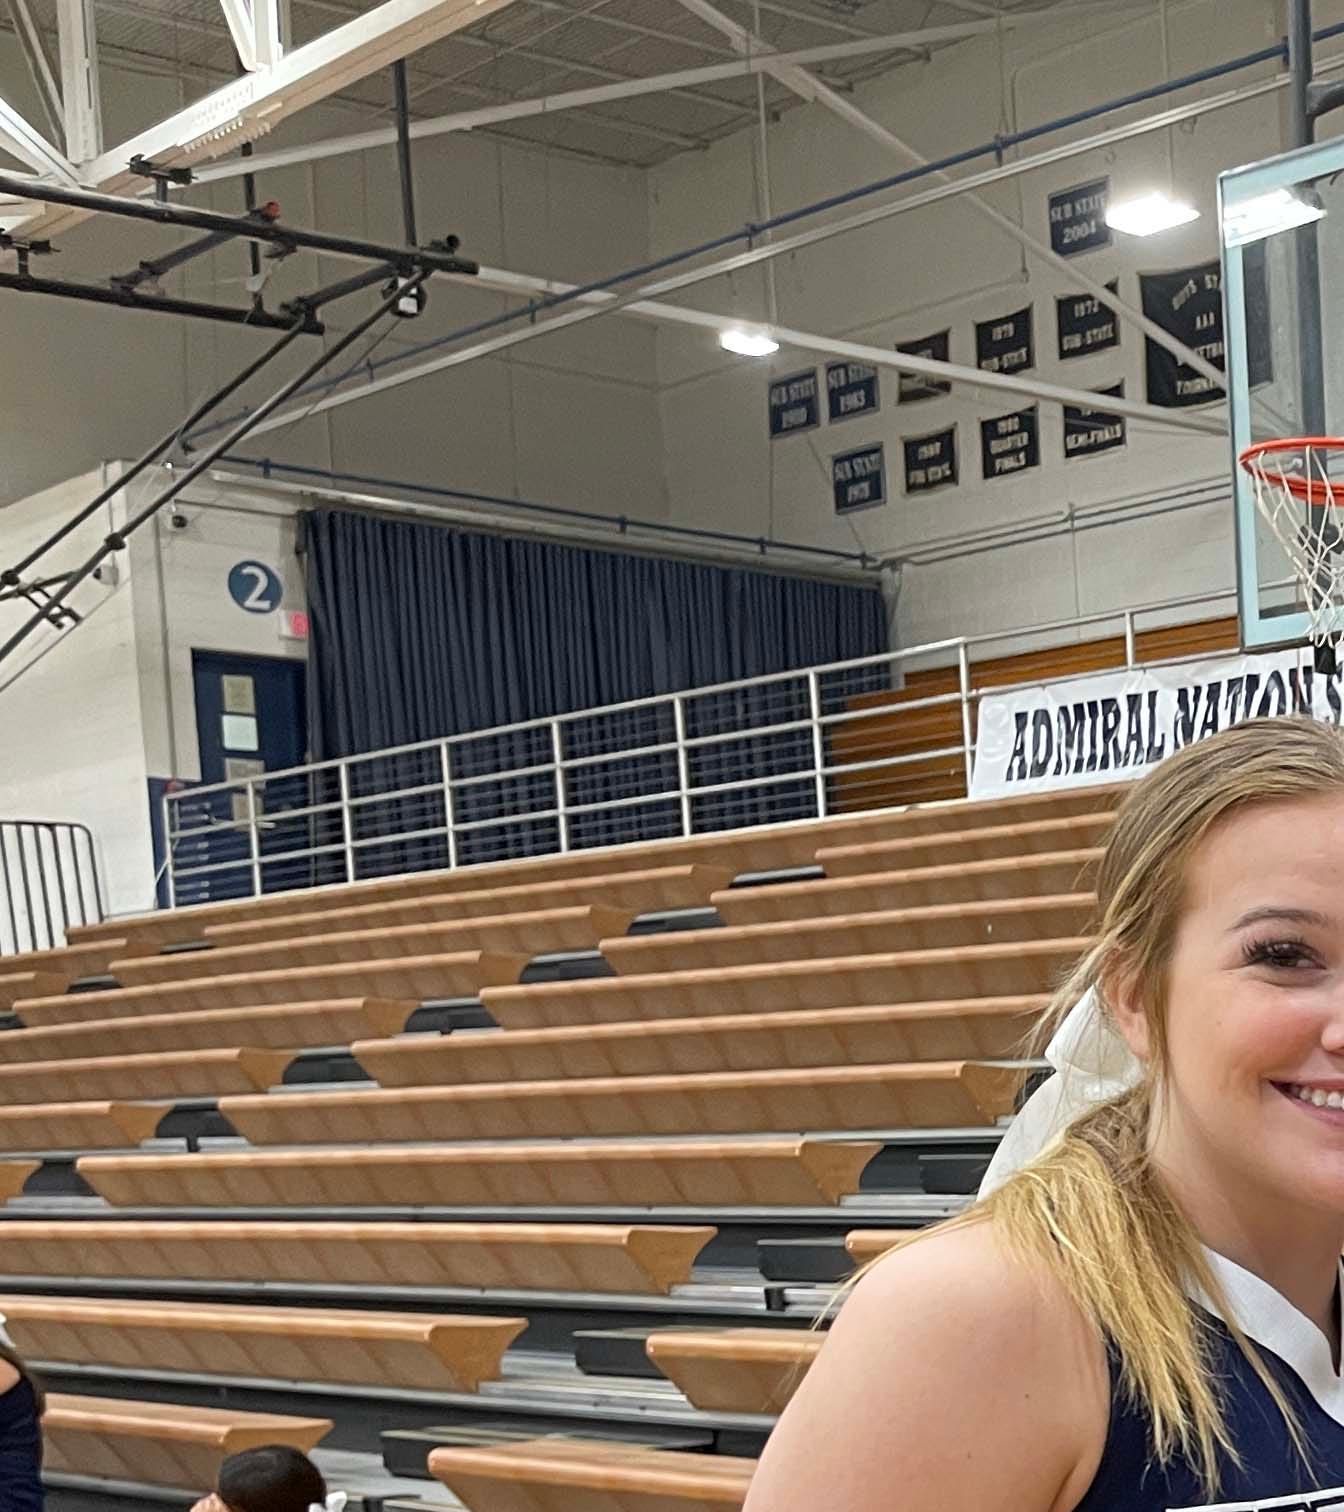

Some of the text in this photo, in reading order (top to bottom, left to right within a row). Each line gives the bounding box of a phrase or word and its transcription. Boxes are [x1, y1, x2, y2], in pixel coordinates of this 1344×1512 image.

[1063, 221, 1097, 244] 2004
[241, 564, 272, 610] 2
[1005, 689, 1166, 782] ADMIRAL
[1173, 664, 1314, 750] NATION
